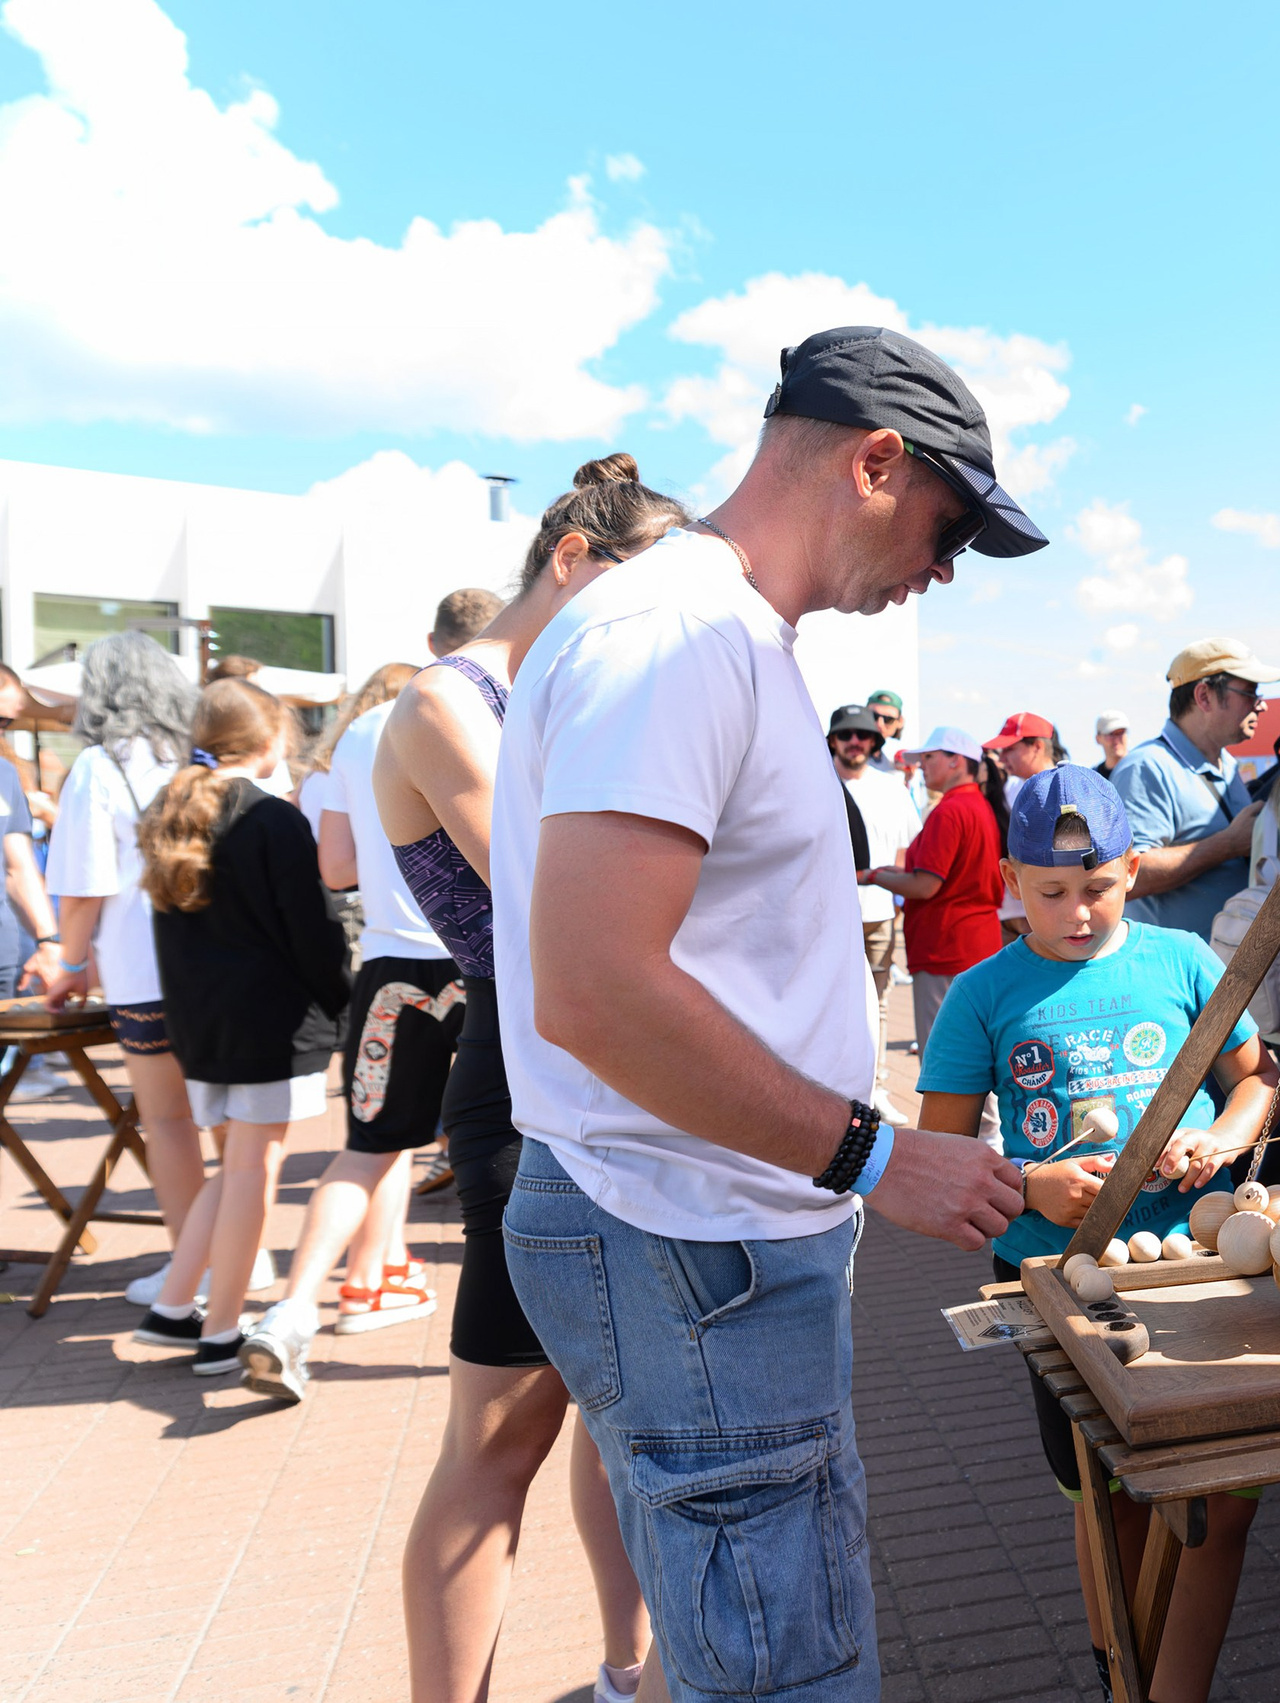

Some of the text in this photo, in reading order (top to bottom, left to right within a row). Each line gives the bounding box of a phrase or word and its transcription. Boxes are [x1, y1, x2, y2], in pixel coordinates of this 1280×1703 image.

[1037, 994, 1133, 1021] KIDS TEAM
[1064, 1029, 1114, 1048] RACE
[1069, 1061, 1114, 1075] KIDS TEAM
[1021, 1073, 1047, 1086] CHAMP
[1085, 1081, 1105, 1089] KIDS
[1107, 1075, 1136, 1086] RACING
[1124, 1196, 1172, 1228] RIDER
